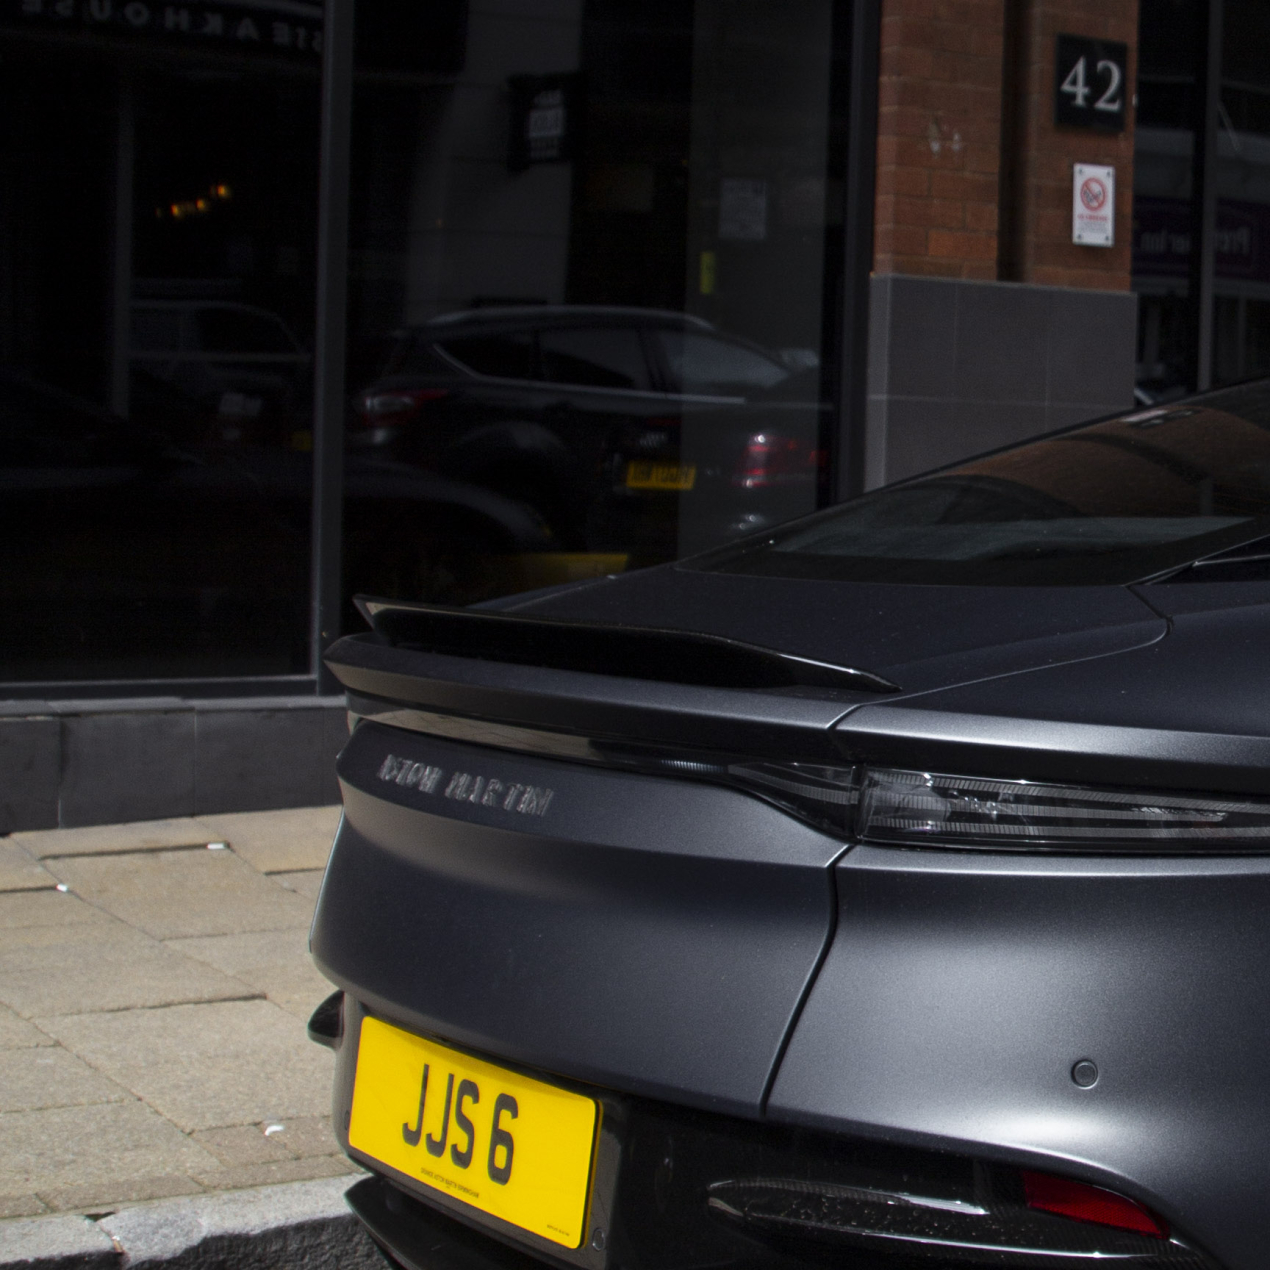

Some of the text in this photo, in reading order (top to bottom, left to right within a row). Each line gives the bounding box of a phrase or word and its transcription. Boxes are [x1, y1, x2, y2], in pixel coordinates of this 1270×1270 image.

[1060, 54, 1122, 112] 42
[402, 1063, 519, 1186] JJS 6
